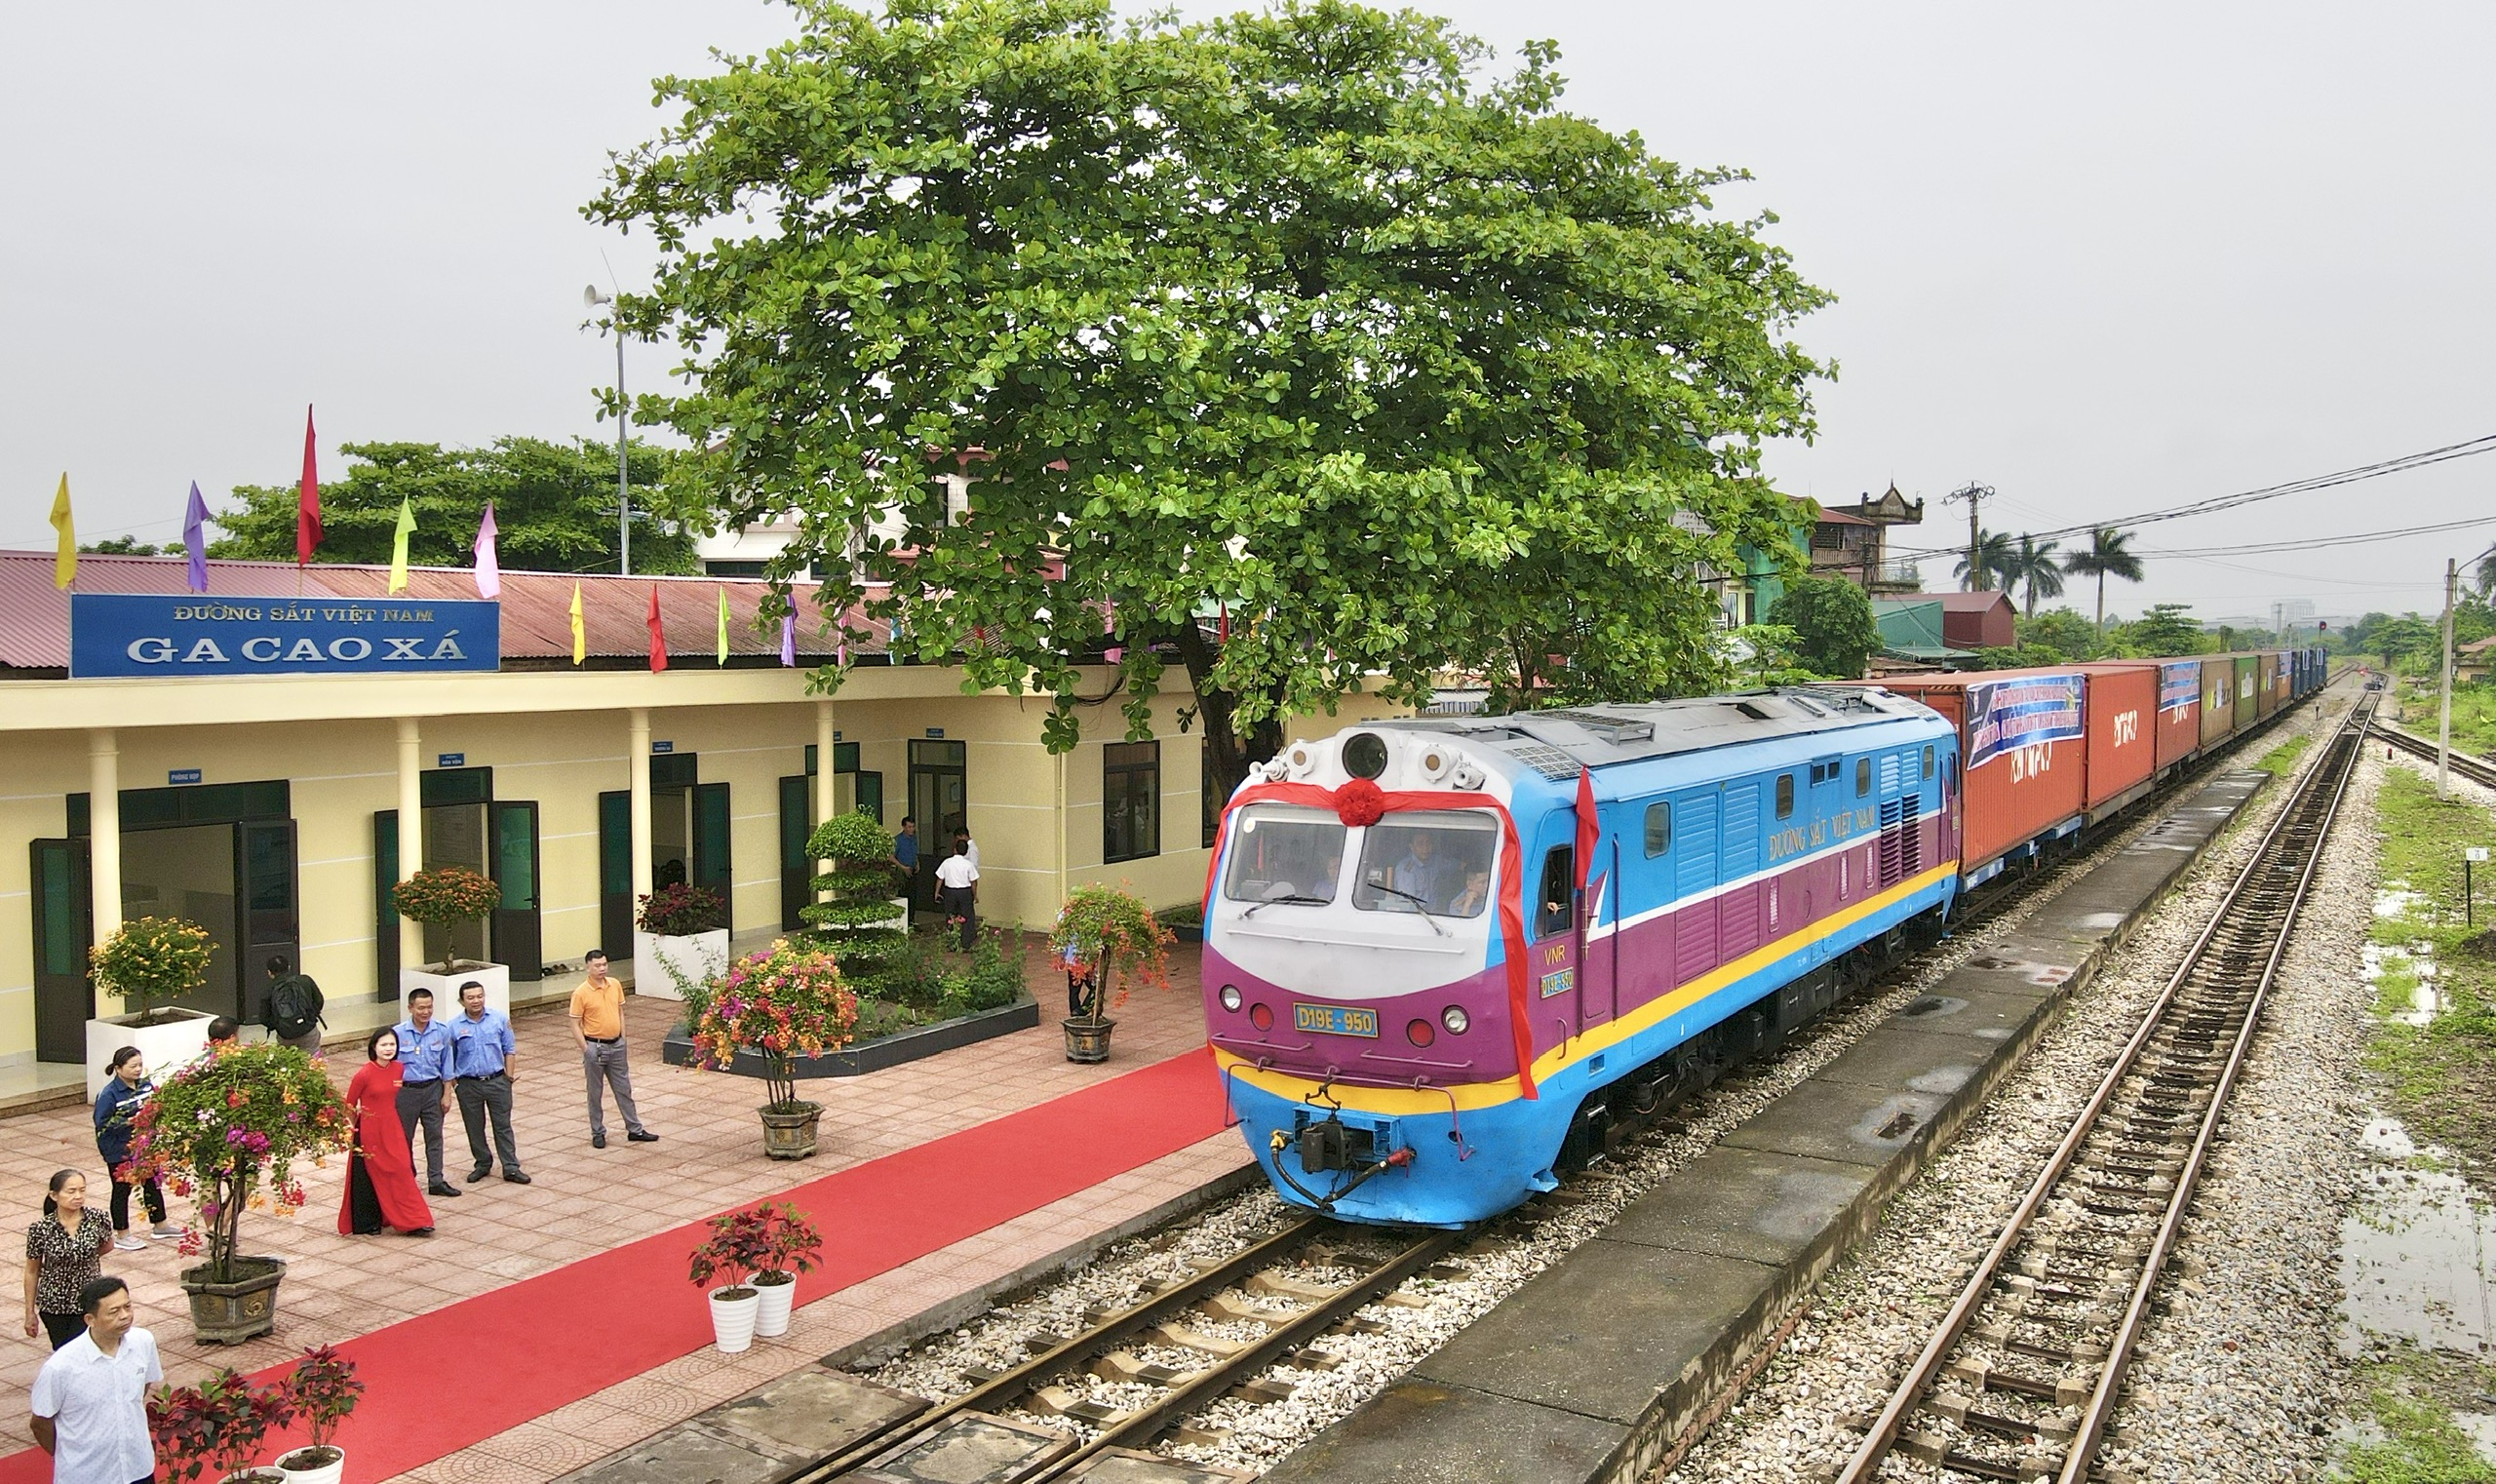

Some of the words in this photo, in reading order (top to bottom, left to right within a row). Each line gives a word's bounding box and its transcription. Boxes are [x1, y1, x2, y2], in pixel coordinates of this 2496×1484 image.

[174, 602, 262, 621] ĐƯỜNG
[270, 601, 315, 622] SẮT
[322, 605, 376, 625] VIỆT
[382, 608, 435, 623] NAM
[127, 637, 230, 664] GA
[241, 637, 372, 663] CAO
[381, 629, 468, 661] XÁ
[1855, 804, 1875, 832] NAM
[1544, 944, 1566, 966] VNR
